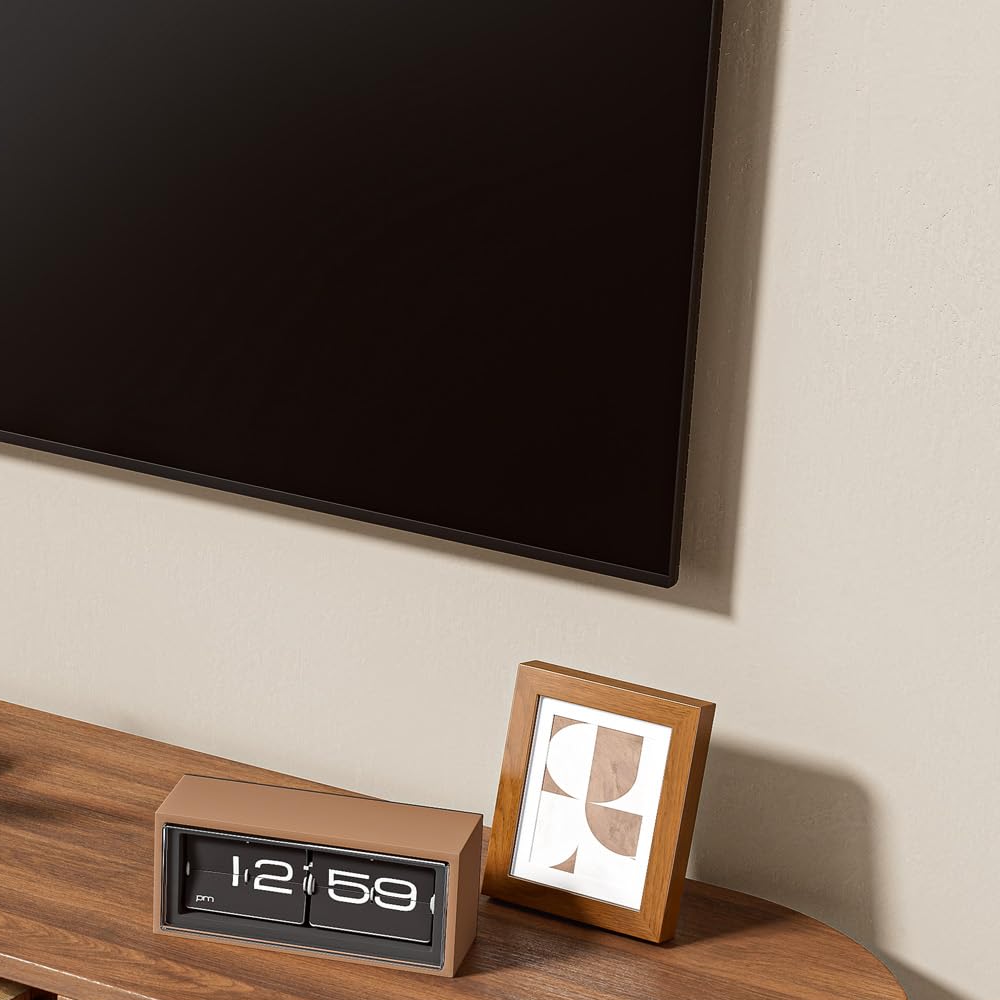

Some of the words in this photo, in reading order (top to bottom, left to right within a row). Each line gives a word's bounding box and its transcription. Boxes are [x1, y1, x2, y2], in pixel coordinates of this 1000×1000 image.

[195, 895, 214, 903] pm
[232, 855, 293, 895] 12
[328, 868, 417, 912] 59
